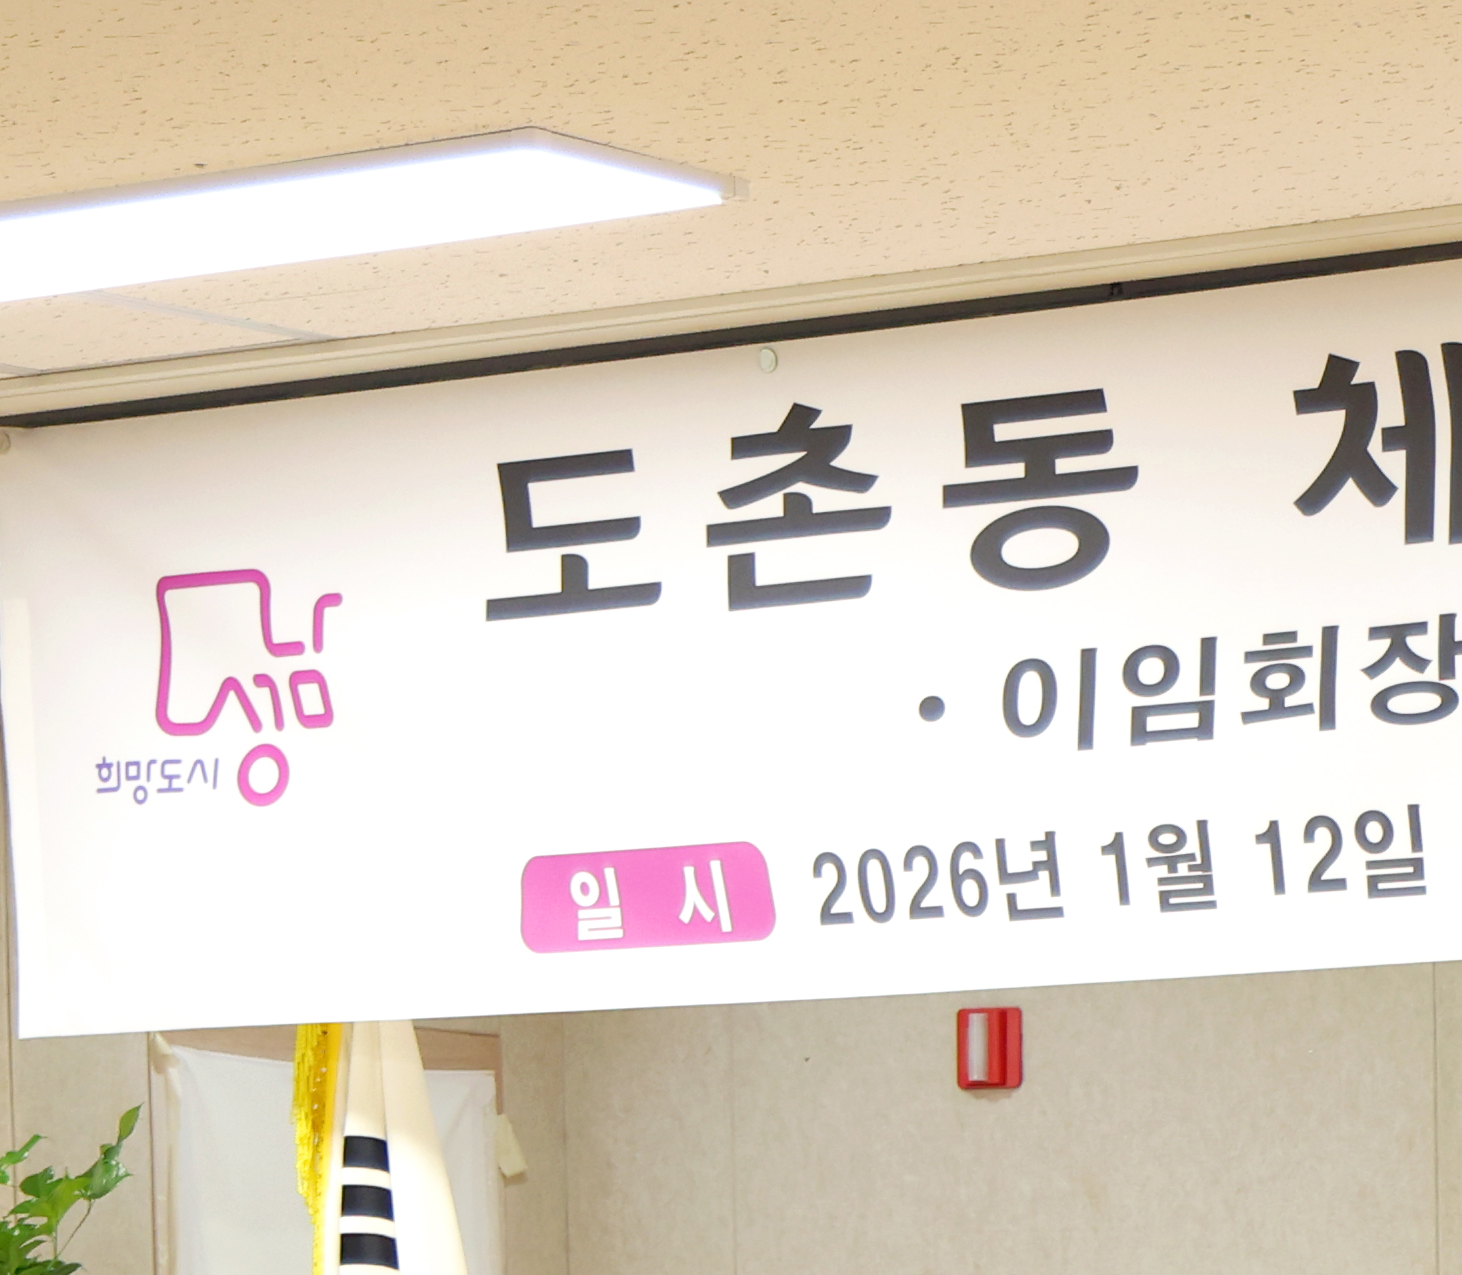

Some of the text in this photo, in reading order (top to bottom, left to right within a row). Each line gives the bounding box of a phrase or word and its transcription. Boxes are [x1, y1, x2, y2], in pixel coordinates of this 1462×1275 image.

[486, 388, 1138, 621] 도촌동
[95, 756, 219, 805] 희망도시
[812, 830, 1064, 926] 2026년
[1100, 819, 1217, 913] 1월
[1254, 803, 1427, 899] 12일
